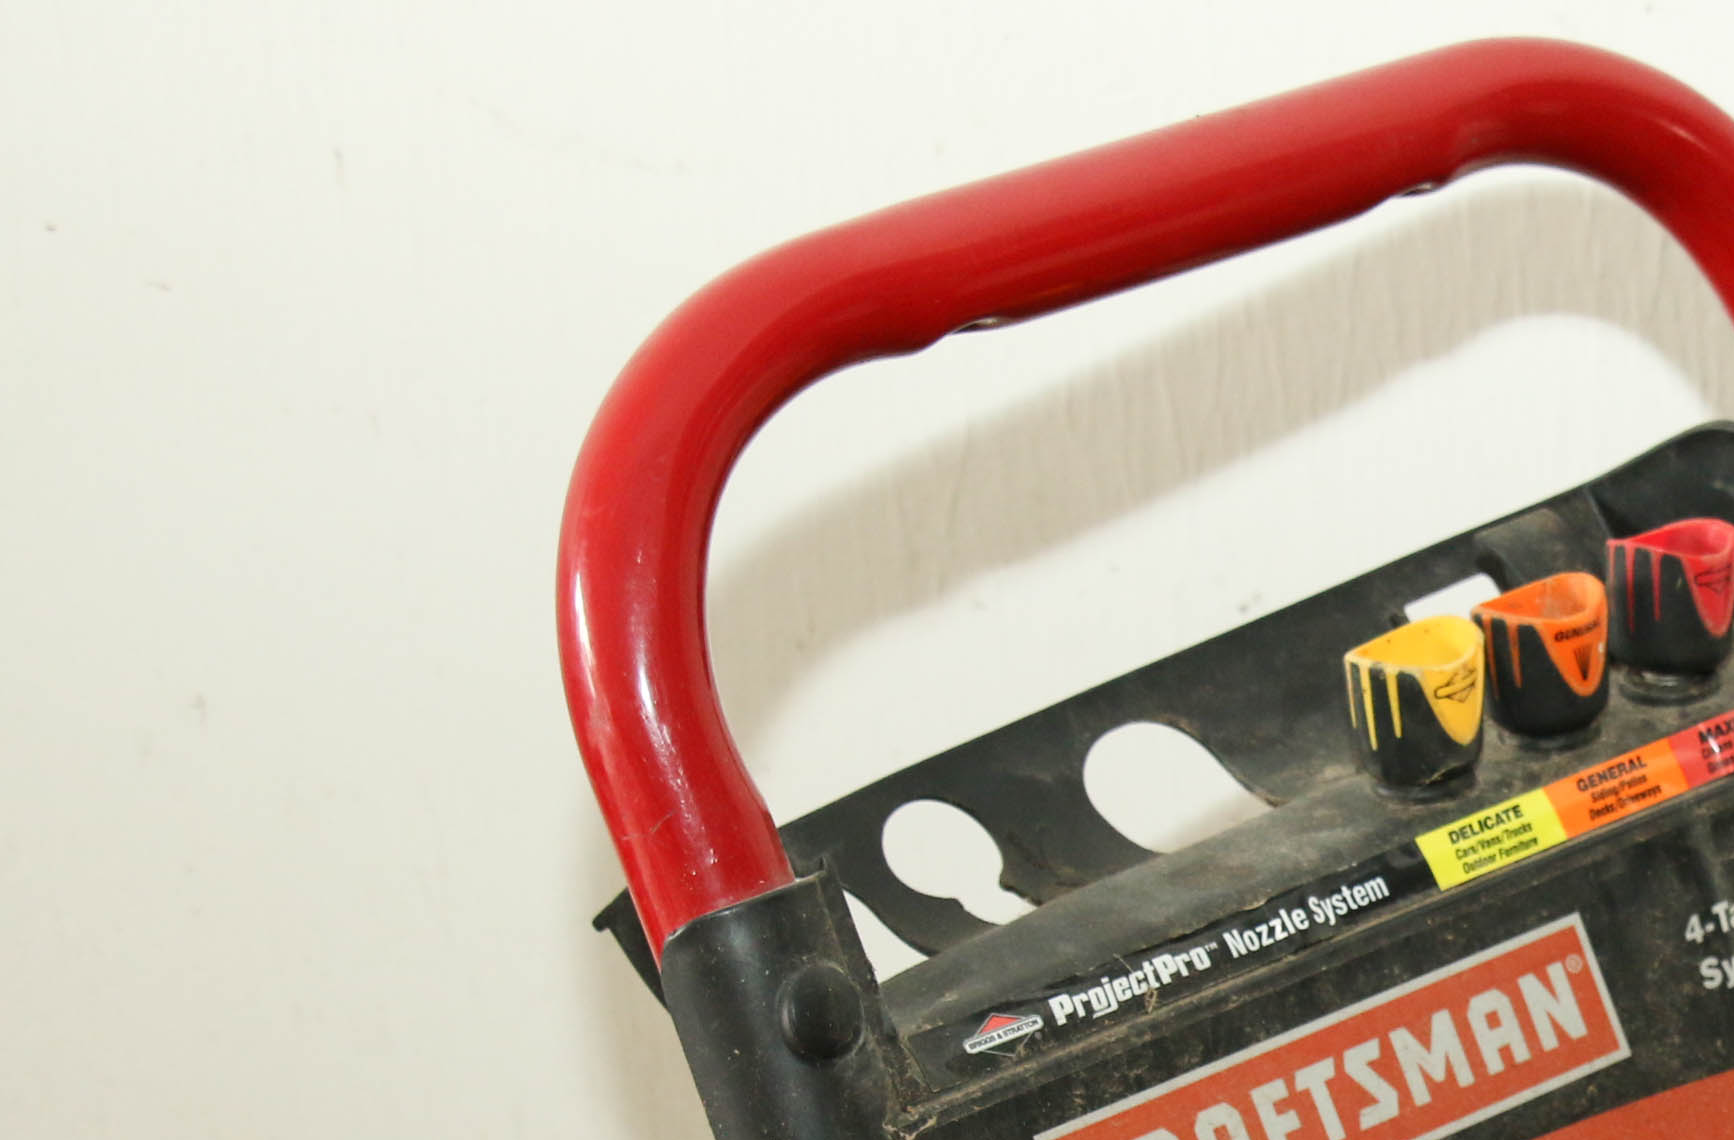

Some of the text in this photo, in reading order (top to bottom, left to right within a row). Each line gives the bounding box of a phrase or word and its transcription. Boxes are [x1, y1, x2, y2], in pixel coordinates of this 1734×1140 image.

[1577, 756, 1647, 792] GENERAL
[1448, 804, 1524, 844] DELICATE
[1223, 905, 1308, 959] Nozzle
[1308, 876, 1390, 927] System
